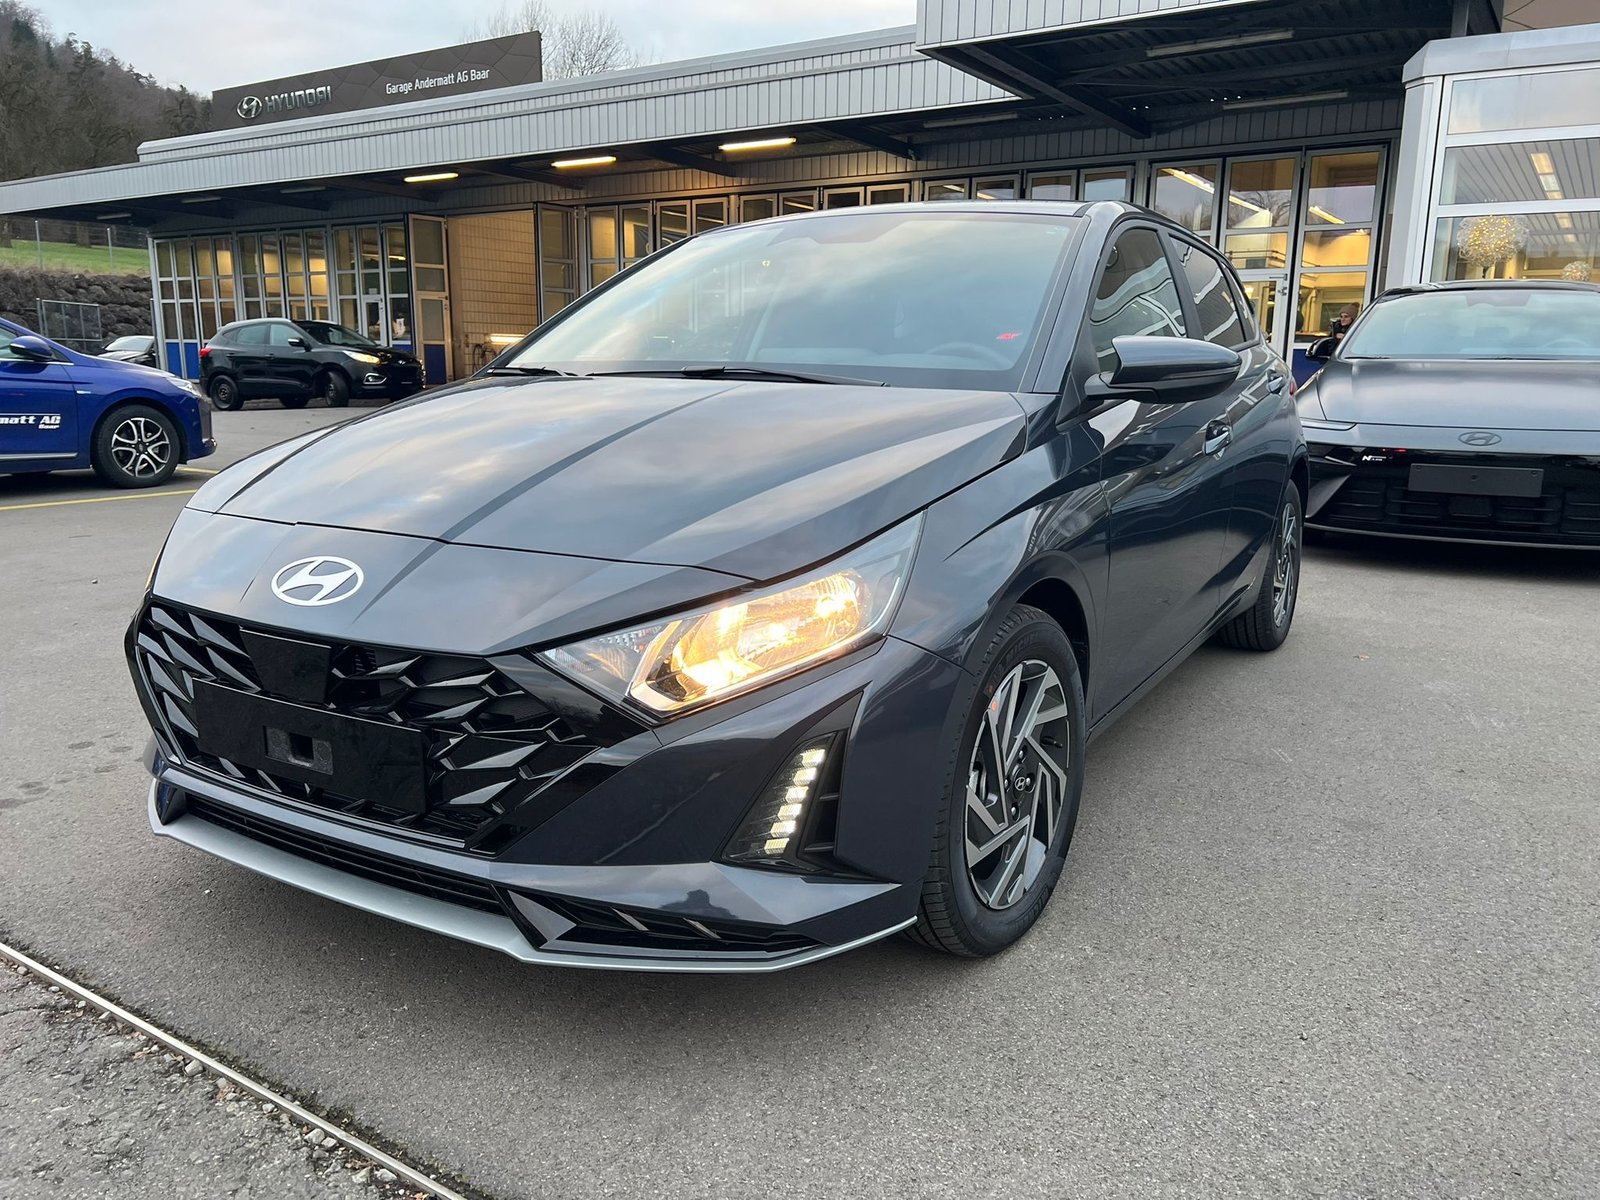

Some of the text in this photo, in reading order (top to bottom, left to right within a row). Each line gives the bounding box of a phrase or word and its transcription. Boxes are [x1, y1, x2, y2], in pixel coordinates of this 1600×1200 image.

[386, 69, 490, 95] Garage Andermatt AG Baar
[264, 85, 332, 113] HYUNDAI
[40, 415, 61, 424] AG
